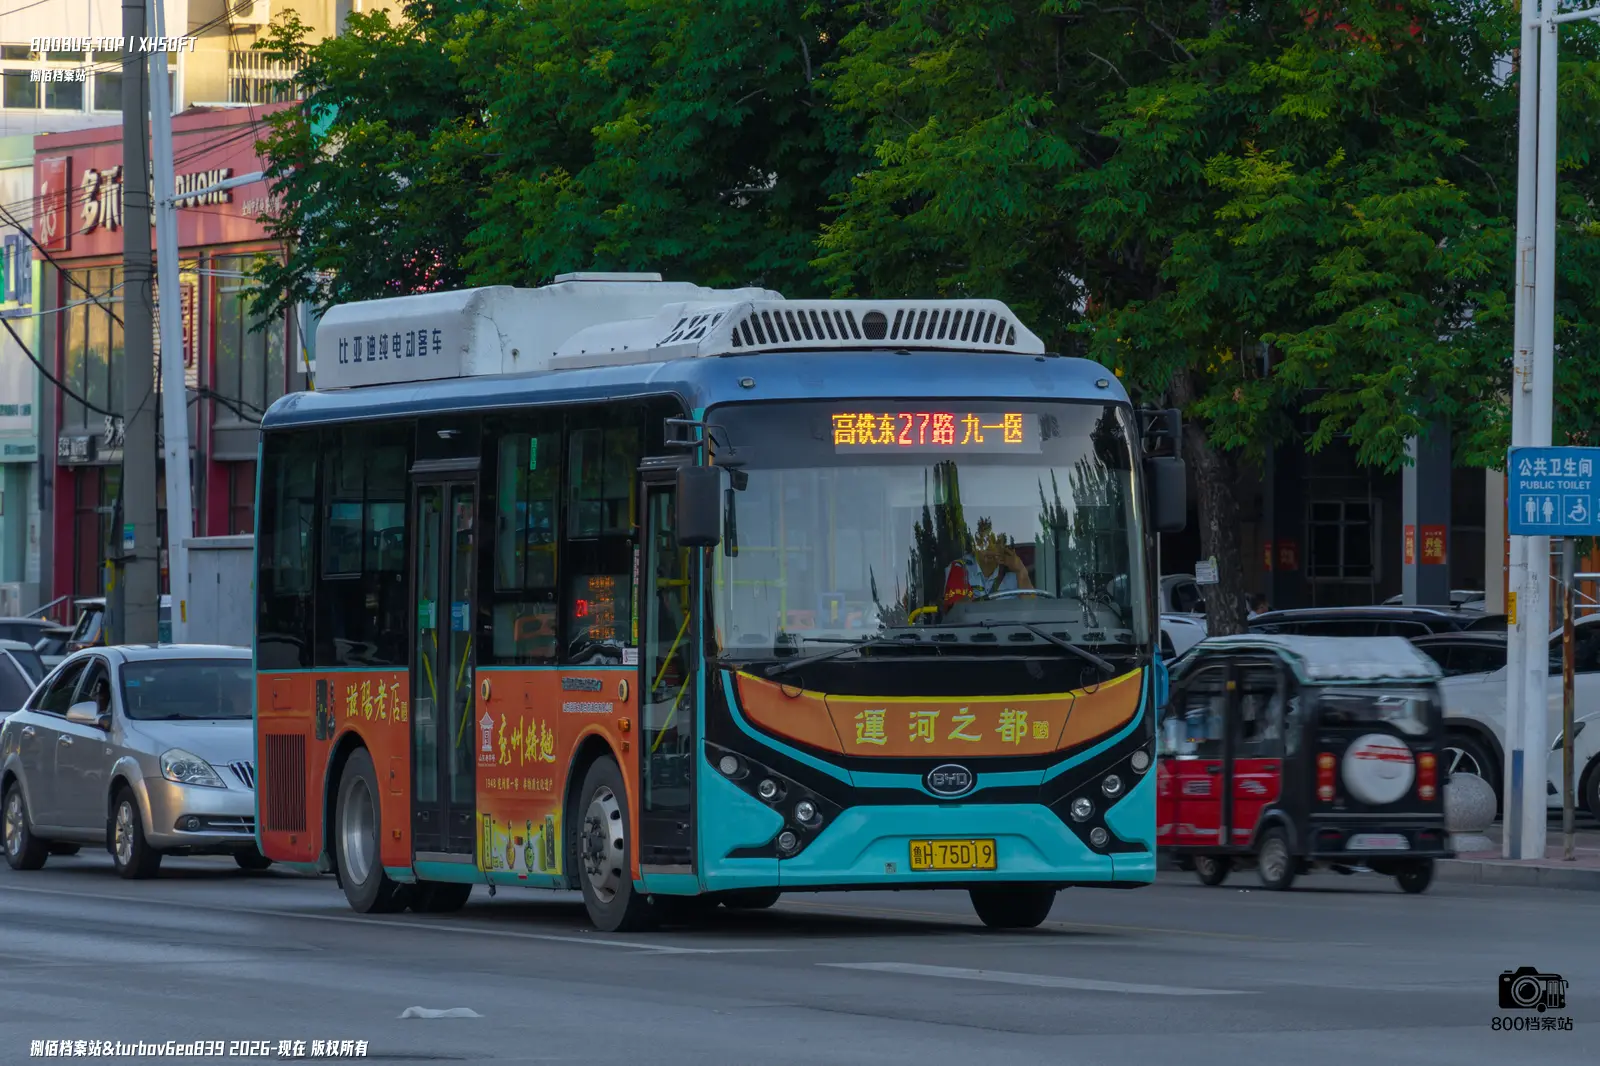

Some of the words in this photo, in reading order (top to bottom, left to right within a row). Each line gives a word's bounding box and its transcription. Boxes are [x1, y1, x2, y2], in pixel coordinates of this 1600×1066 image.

[338, 327, 443, 365] 比亚迪纯电动客车
[961, 413, 1022, 444] 九一医
[1519, 457, 1593, 477] 公共卫生间
[1520, 481, 1555, 490] PUBLIC
[1557, 481, 1591, 490] TOILET
[854, 707, 1028, 746] 運河之都
[933, 772, 967, 786] BYD
